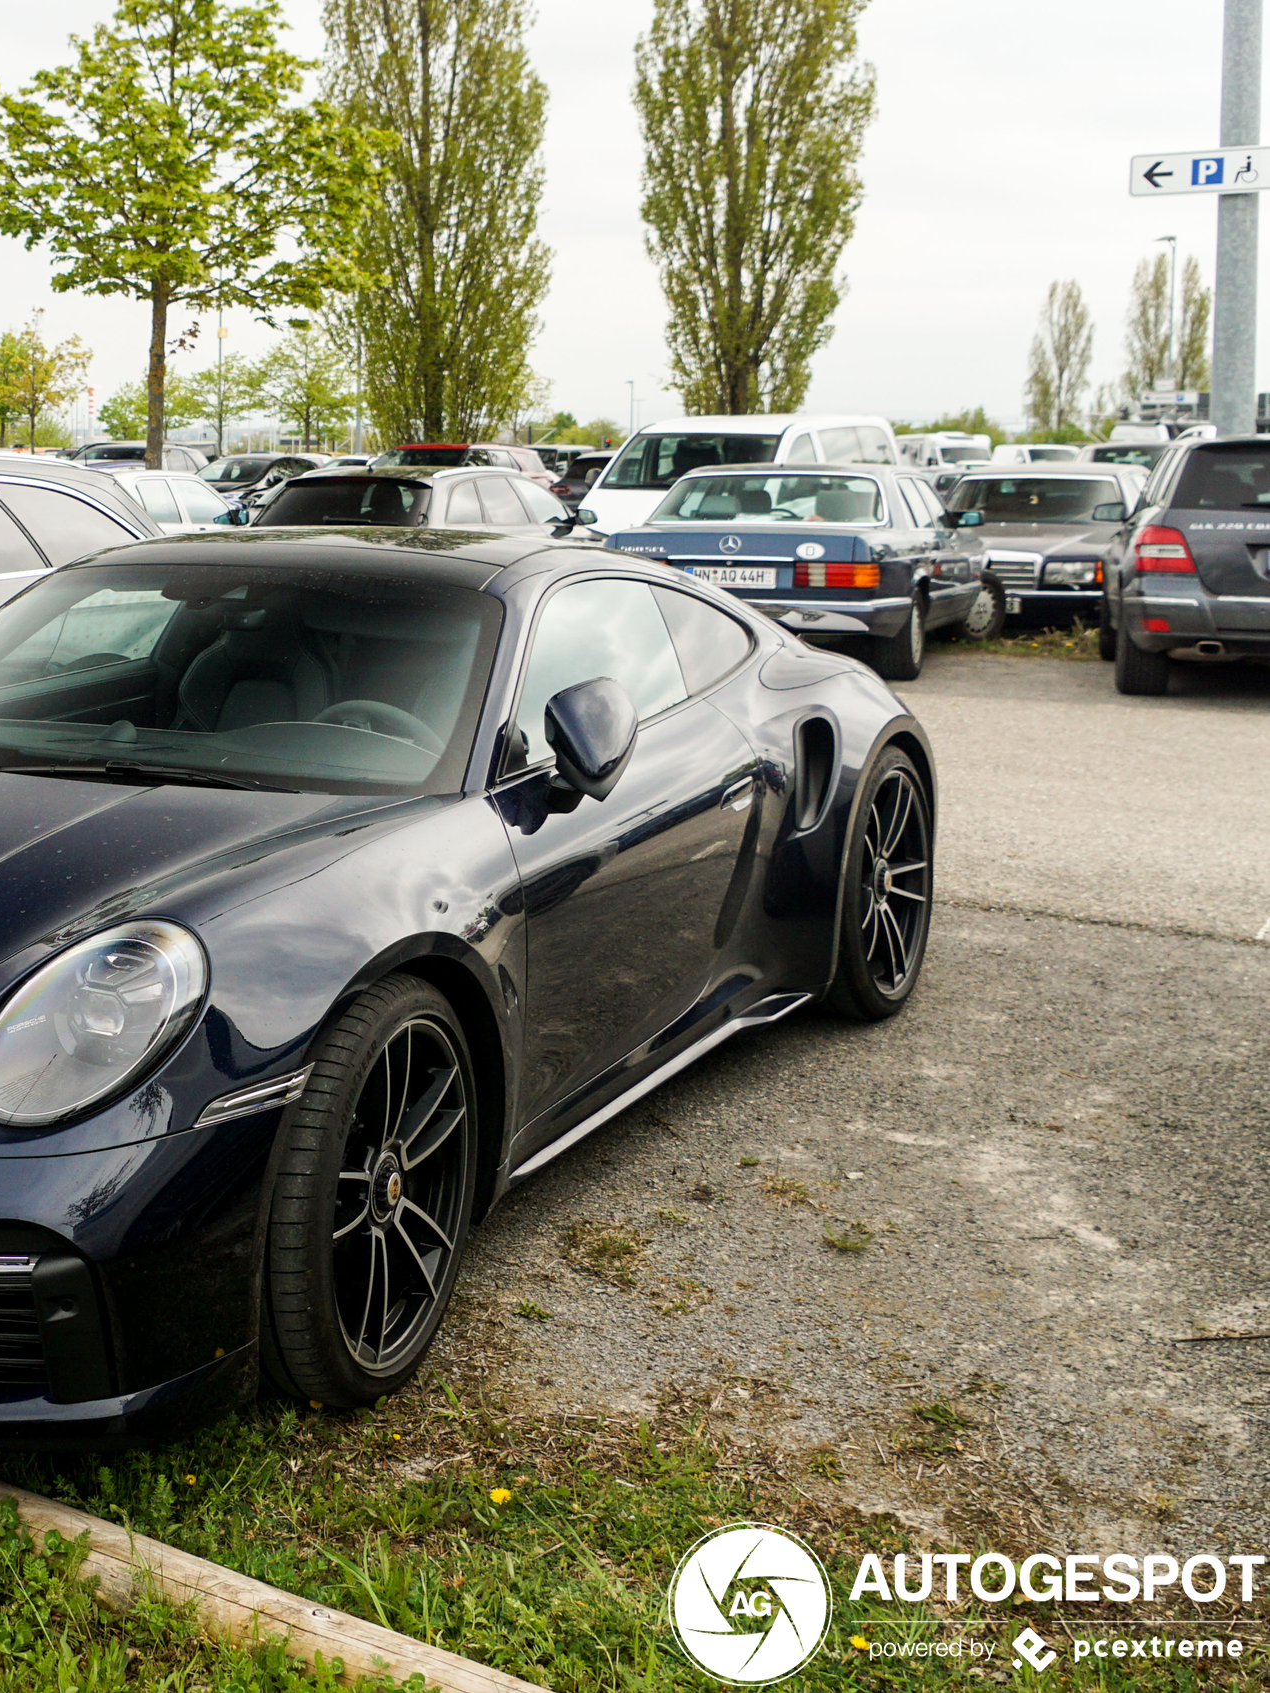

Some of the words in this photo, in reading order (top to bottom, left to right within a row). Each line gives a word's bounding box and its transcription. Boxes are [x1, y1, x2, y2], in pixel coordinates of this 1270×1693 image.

[1197, 159, 1218, 185] P
[805, 546, 816, 557] D
[719, 570, 737, 583] AQ
[740, 570, 765, 583] 44H
